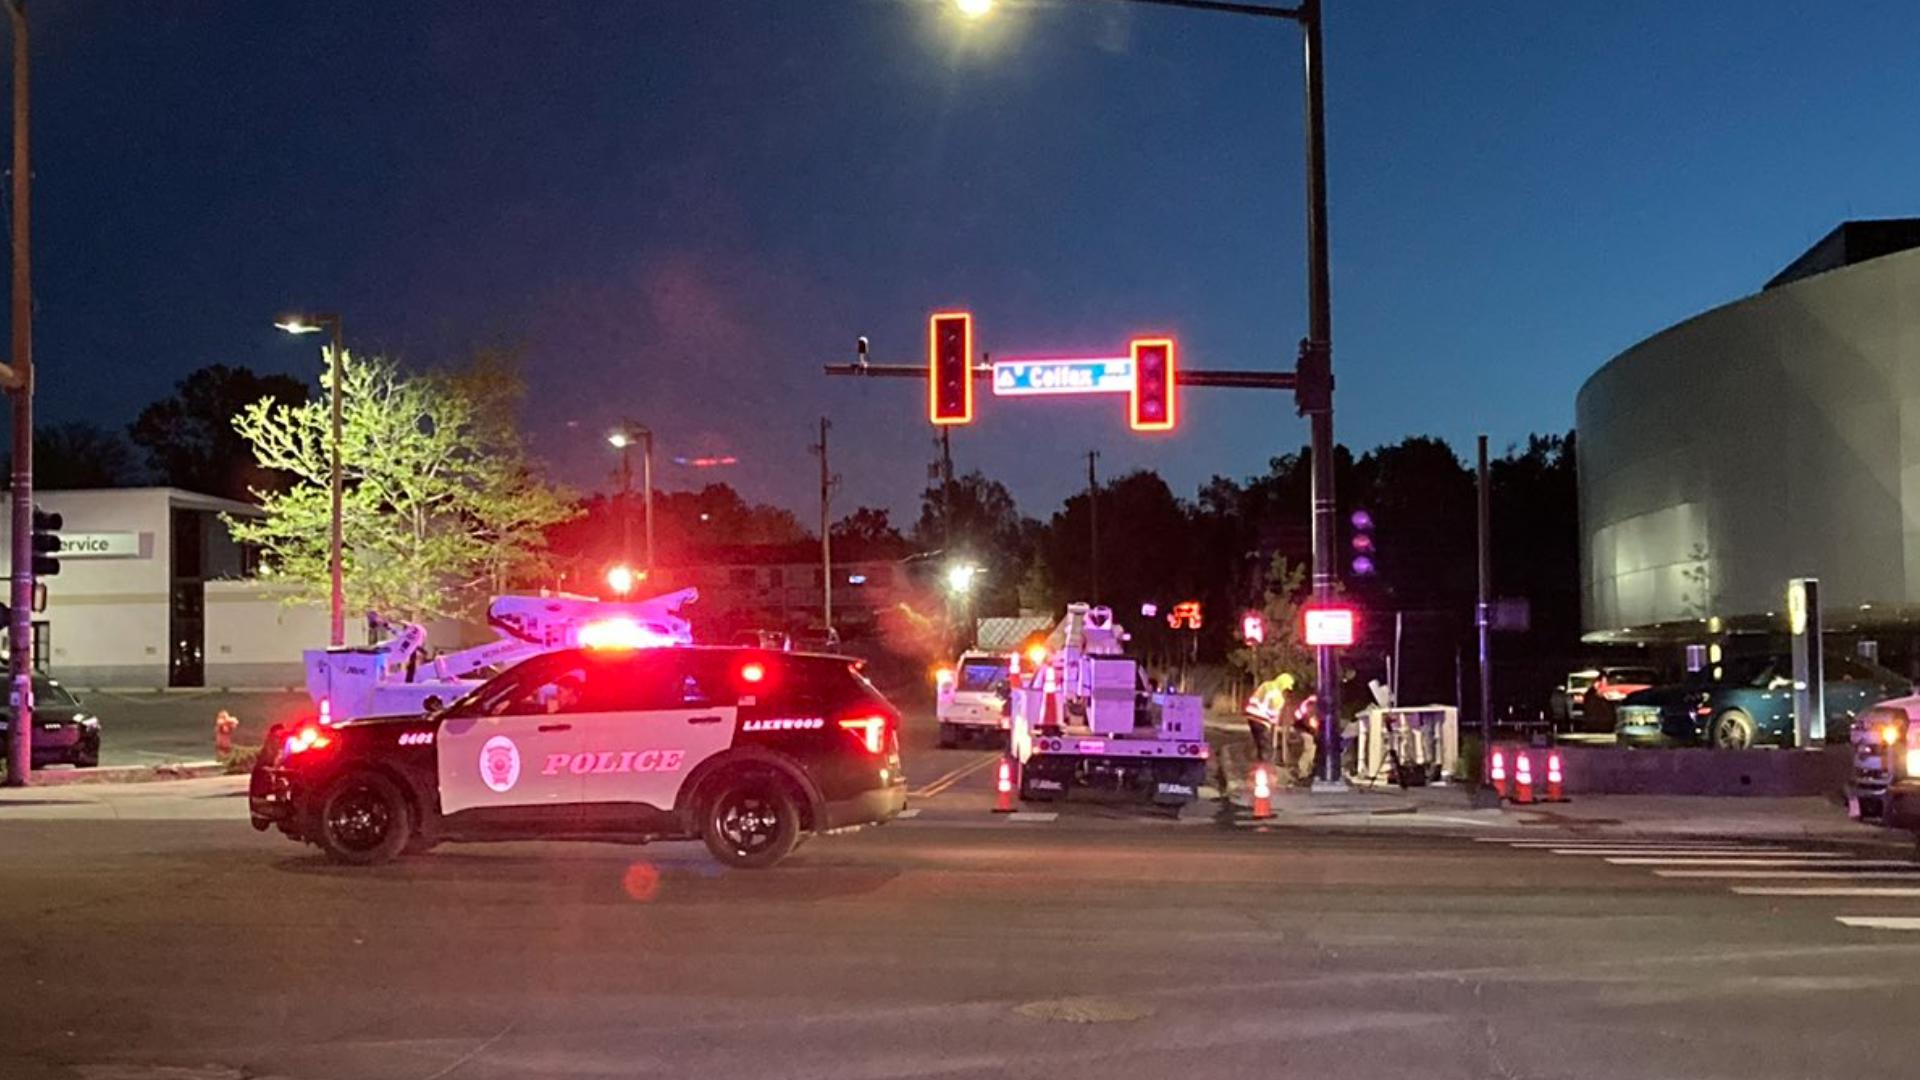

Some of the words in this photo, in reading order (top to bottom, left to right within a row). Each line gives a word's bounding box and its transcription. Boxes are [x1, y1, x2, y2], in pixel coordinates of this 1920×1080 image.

[1029, 365, 1093, 389] Colfax
[60, 535, 109, 551] ervice
[742, 717, 825, 731] LAKEWOOD
[541, 749, 685, 775] POLICE
